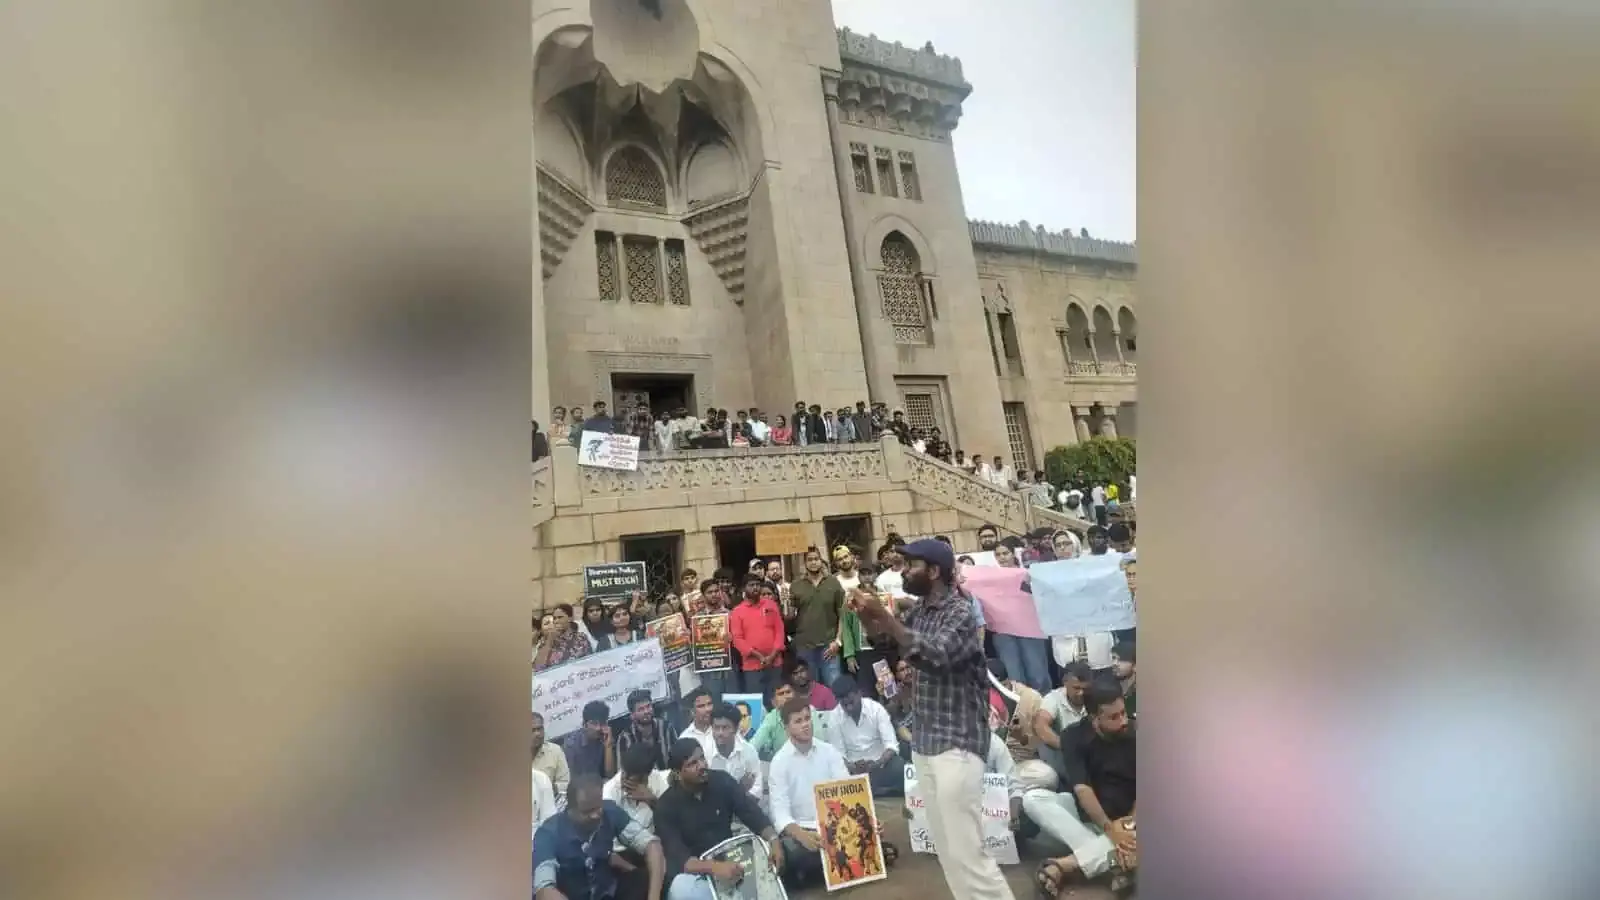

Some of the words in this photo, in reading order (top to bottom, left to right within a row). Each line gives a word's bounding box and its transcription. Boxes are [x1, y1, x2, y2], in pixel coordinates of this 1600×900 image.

[591, 577, 613, 588] MUST
[818, 787, 839, 800] NEW
[840, 783, 865, 796] INDIA
